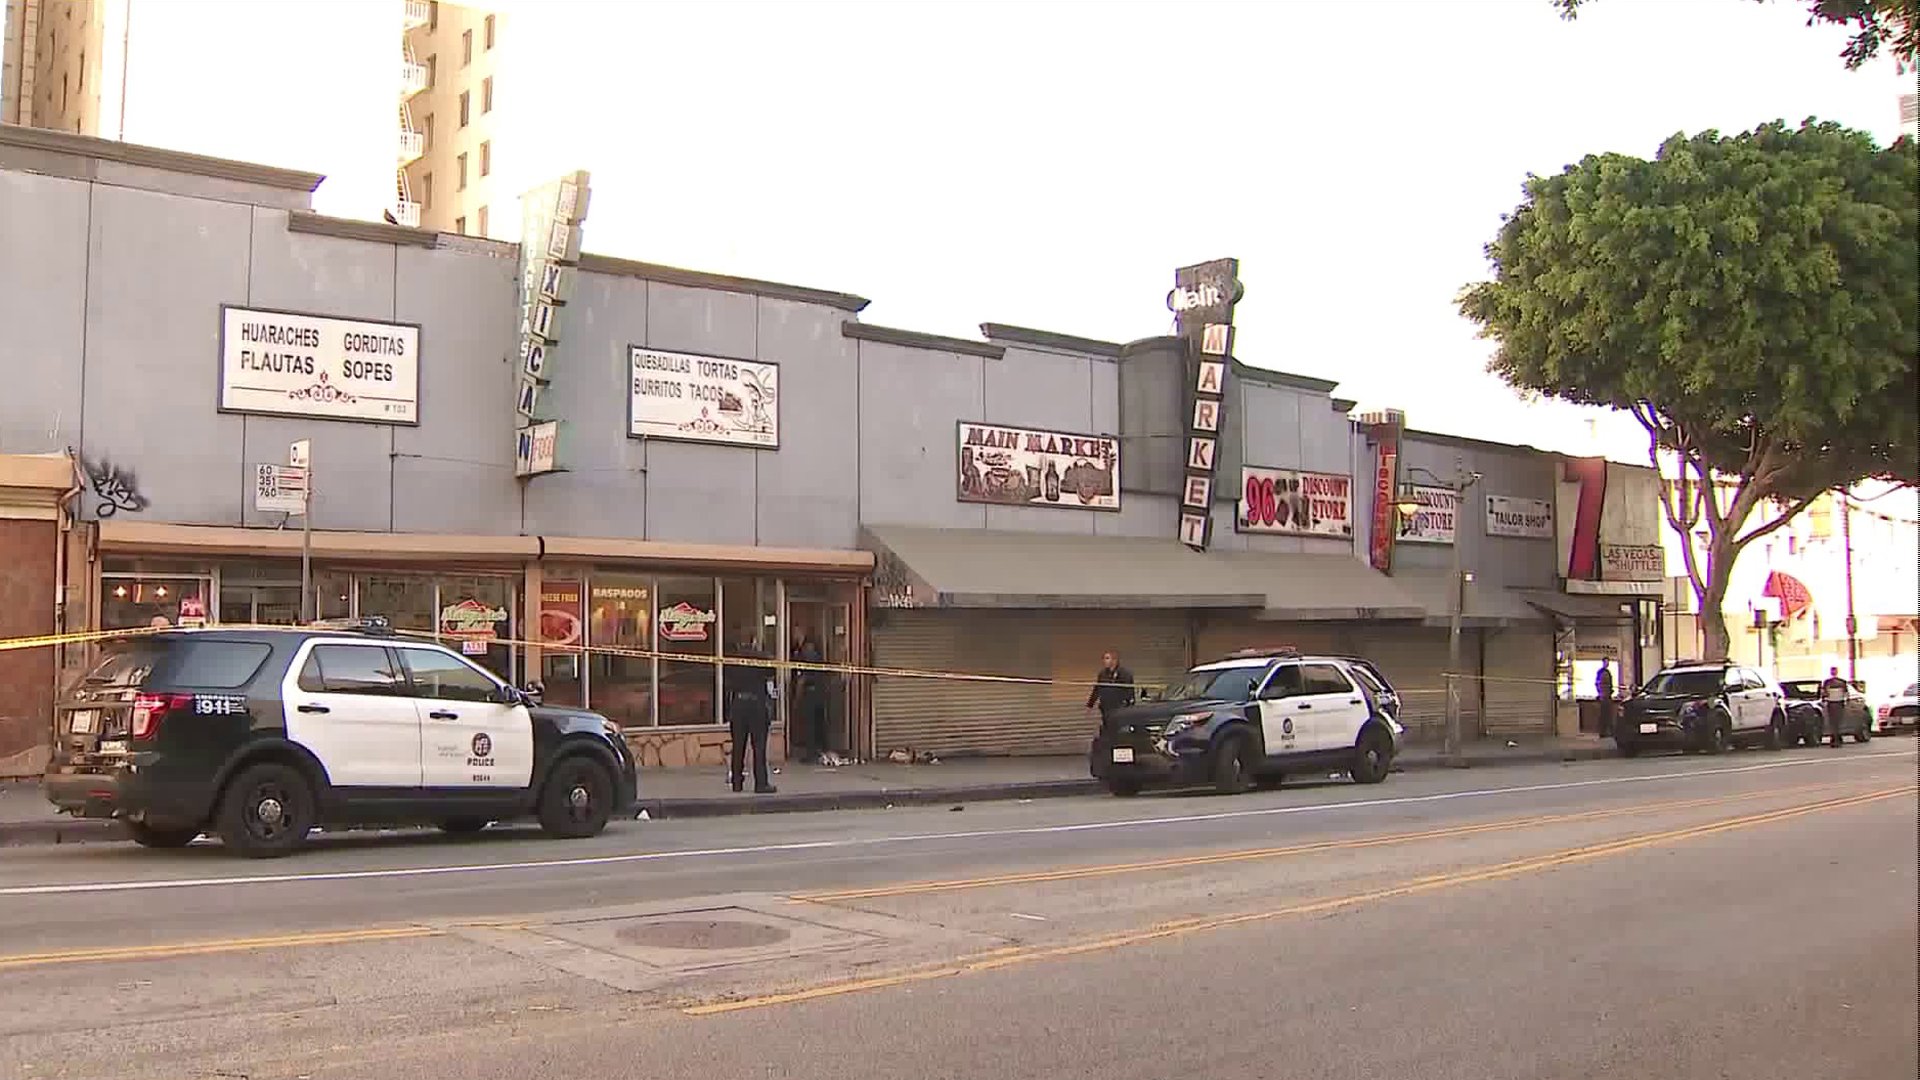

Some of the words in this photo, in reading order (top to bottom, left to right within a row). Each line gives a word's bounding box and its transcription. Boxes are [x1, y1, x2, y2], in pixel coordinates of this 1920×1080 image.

[242, 323, 320, 348] HUARACHES
[343, 333, 404, 356] GORDITAS
[241, 350, 314, 375] FLAUTAS
[342, 359, 393, 382] SOPES
[634, 353, 691, 374] QUESADILLAS
[697, 360, 739, 381] TORTAS
[634, 378, 682, 399] BURRITOS
[689, 383, 724, 401] TACOS
[964, 427, 1021, 449] MAIN
[1184, 325, 1224, 542] MARKET
[259, 465, 273, 475] 60
[259, 476, 276, 486] 351
[258, 487, 277, 497] 760
[1246, 476, 1275, 527] 96
[1302, 477, 1349, 498] DISCOUNT
[1312, 500, 1347, 521] STORE
[1424, 511, 1454, 530] STORE
[1495, 511, 1524, 526] TAILOR
[1603, 548, 1620, 559] LAS
[467, 757, 495, 767] POLICE
